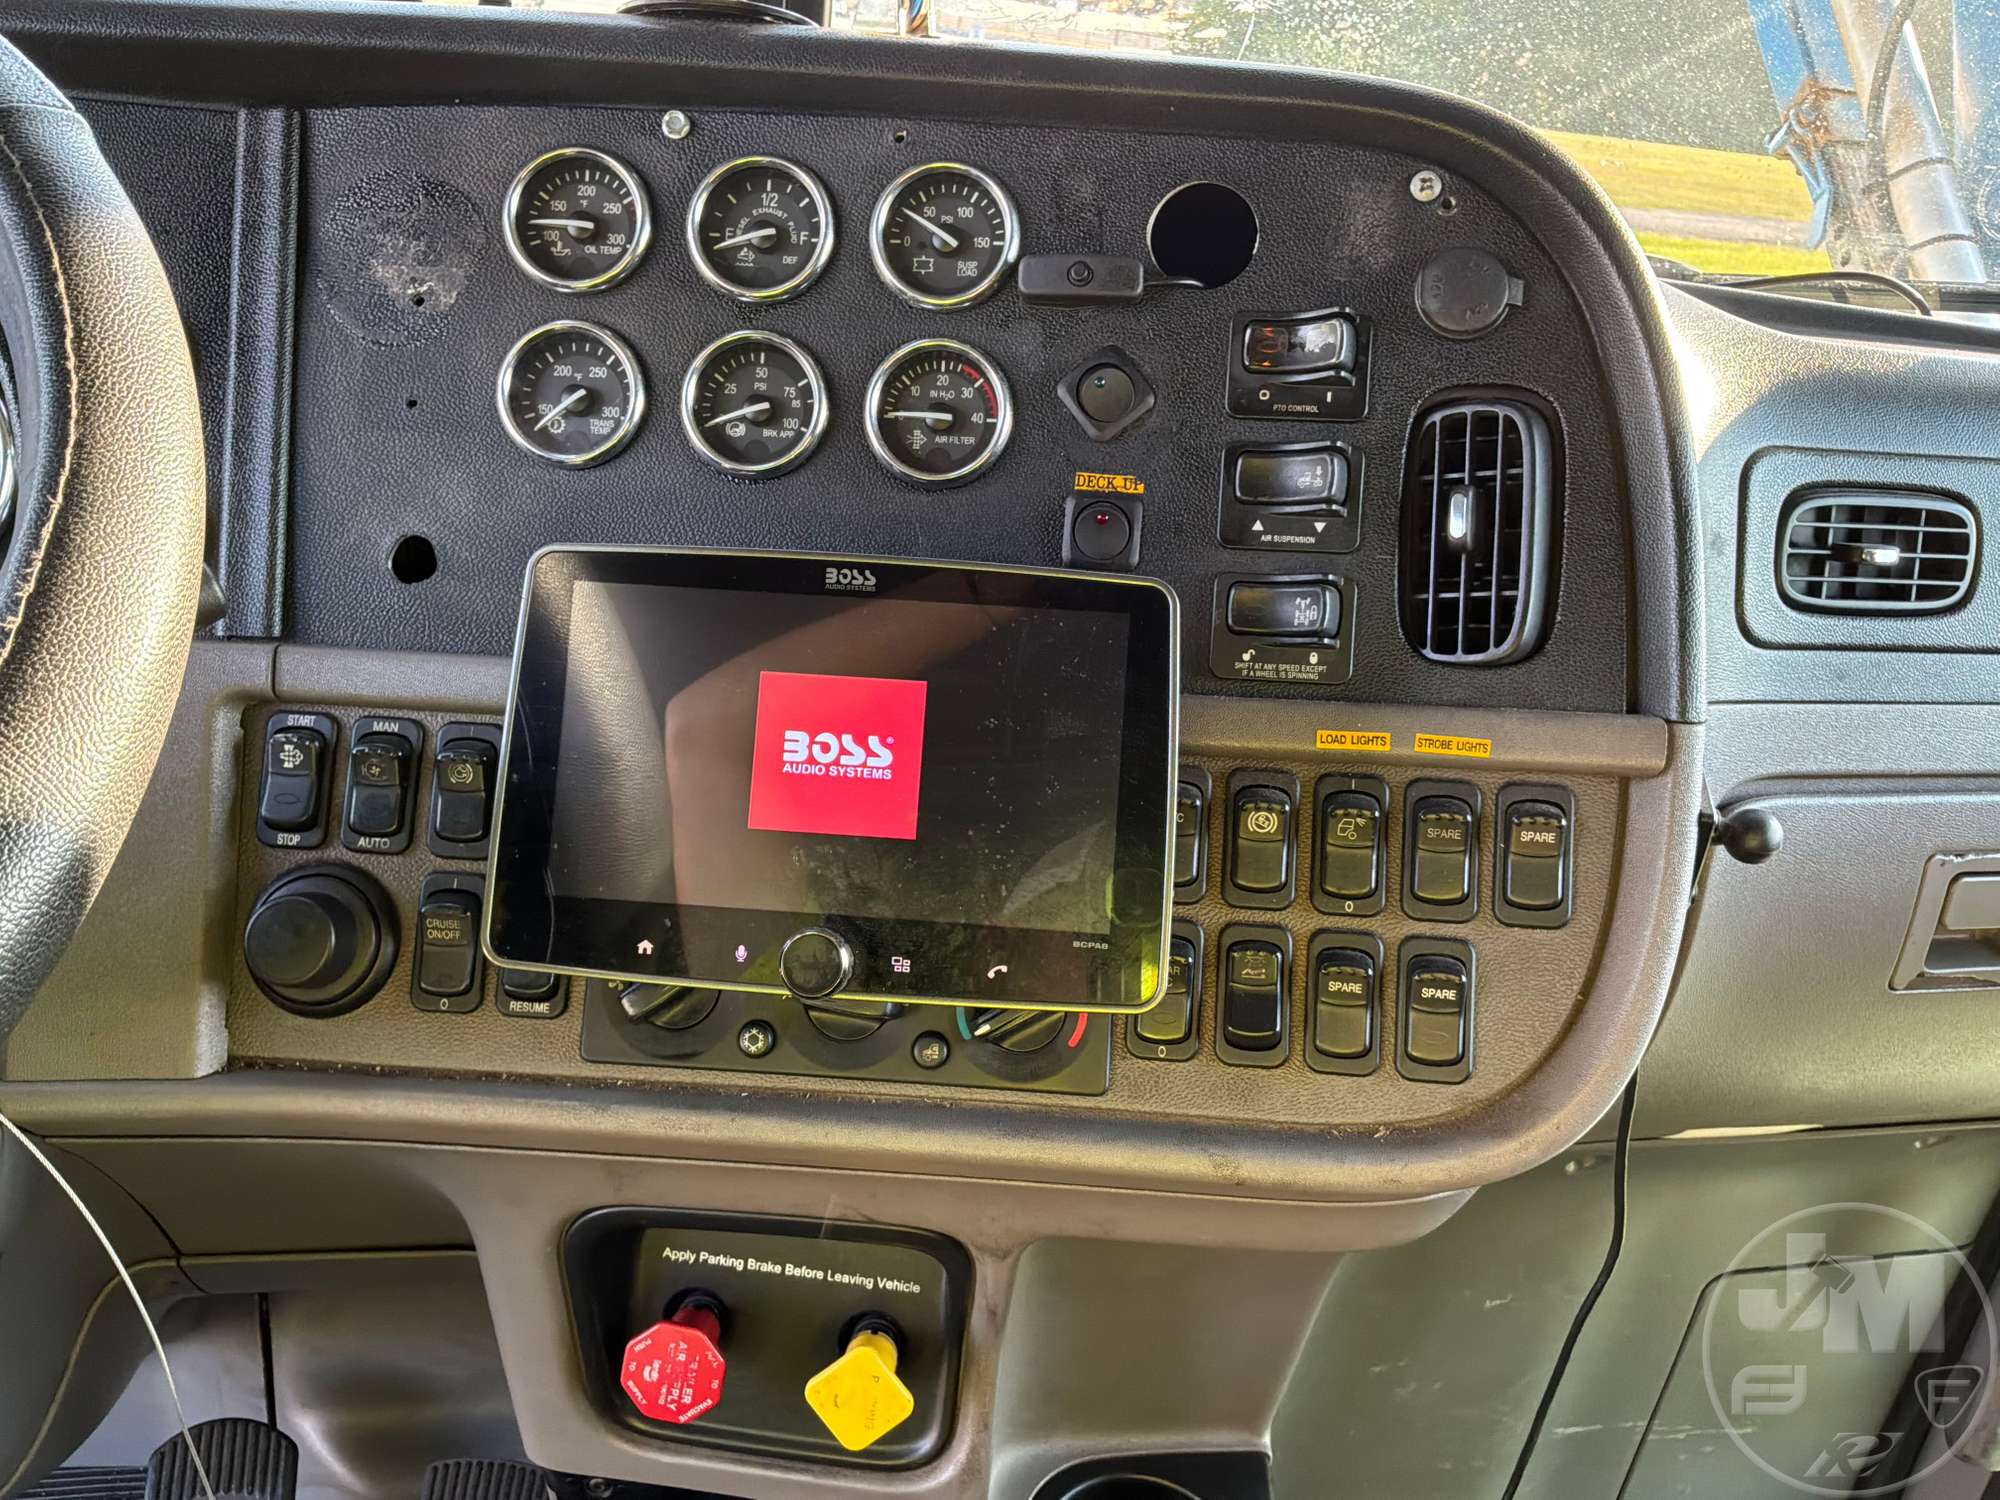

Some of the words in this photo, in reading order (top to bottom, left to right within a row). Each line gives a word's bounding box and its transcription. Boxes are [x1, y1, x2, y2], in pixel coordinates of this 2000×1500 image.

[577, 186, 595, 196] 200
[761, 193, 778, 207] 1/2
[550, 201, 566, 211] 150
[603, 203, 621, 214] 250
[752, 208, 788, 219] EXHAUST
[923, 207, 936, 217] 50
[957, 208, 973, 218] 100
[940, 216, 953, 224] PSI
[544, 231, 559, 241] 100
[606, 234, 625, 245] 300
[800, 232, 808, 245] F
[904, 236, 911, 246] 0
[974, 238, 990, 248] 150
[584, 246, 597, 254] OIL
[599, 246, 622, 255] TEMP
[782, 256, 798, 264] DEF
[957, 268, 977, 277] LOAD
[554, 366, 572, 377] 200
[589, 367, 607, 378] 250
[756, 368, 768, 379] 50
[936, 374, 948, 386] 20
[724, 384, 736, 394] 25
[754, 382, 767, 391] PSI
[911, 386, 920, 396] 10
[784, 387, 796, 398] 75
[961, 388, 973, 398] 30
[538, 404, 553, 415] 150
[792, 400, 800, 408] 85
[1273, 404, 1287, 412] PTO
[1288, 404, 1319, 413] CONTROL
[602, 407, 620, 418] 300
[590, 418, 614, 427] TRANS
[782, 418, 798, 430] 100
[970, 414, 983, 424] 40
[590, 427, 610, 435] TEMP
[779, 430, 794, 438] APP
[935, 436, 948, 444] AIR
[949, 436, 976, 445] FILTER
[1076, 474, 1117, 490] DECK
[1260, 534, 1273, 542] AIR
[1274, 535, 1316, 544] SUSPENSION
[826, 568, 877, 586] BOSS
[1234, 662, 1254, 670] SHIFT
[1278, 664, 1300, 672] SPEED
[1301, 665, 1327, 673] EXCEPT
[1249, 669, 1254, 677] A
[1256, 670, 1278, 678] WHEEL
[1288, 672, 1319, 680] SPINNING
[288, 714, 317, 727] START
[372, 720, 399, 733] MAN
[1320, 734, 1346, 745] LOAD
[1351, 735, 1387, 747] LIGHTS
[1417, 737, 1453, 750] STROBE
[1456, 741, 1489, 754] LIGHTS
[783, 730, 893, 768] BOSS
[783, 763, 825, 776] AUDIO
[828, 765, 892, 780] SYSTEMS
[1426, 828, 1462, 840] SPARE
[1520, 831, 1556, 844] SPARE
[277, 834, 301, 847] STOP
[358, 837, 391, 849] AUTO
[426, 918, 461, 930] CRUISE
[427, 930, 462, 941] ON/OFF
[1328, 980, 1363, 994] SPARE
[1421, 987, 1457, 1001] SPARE
[508, 1001, 550, 1015] RESUME
[662, 1247, 697, 1264] Apply
[699, 1251, 744, 1271] Parking
[747, 1258, 783, 1274] Brake
[784, 1264, 824, 1280] Before
[826, 1269, 873, 1289] Leaving
[876, 1276, 921, 1293] Vehicle
